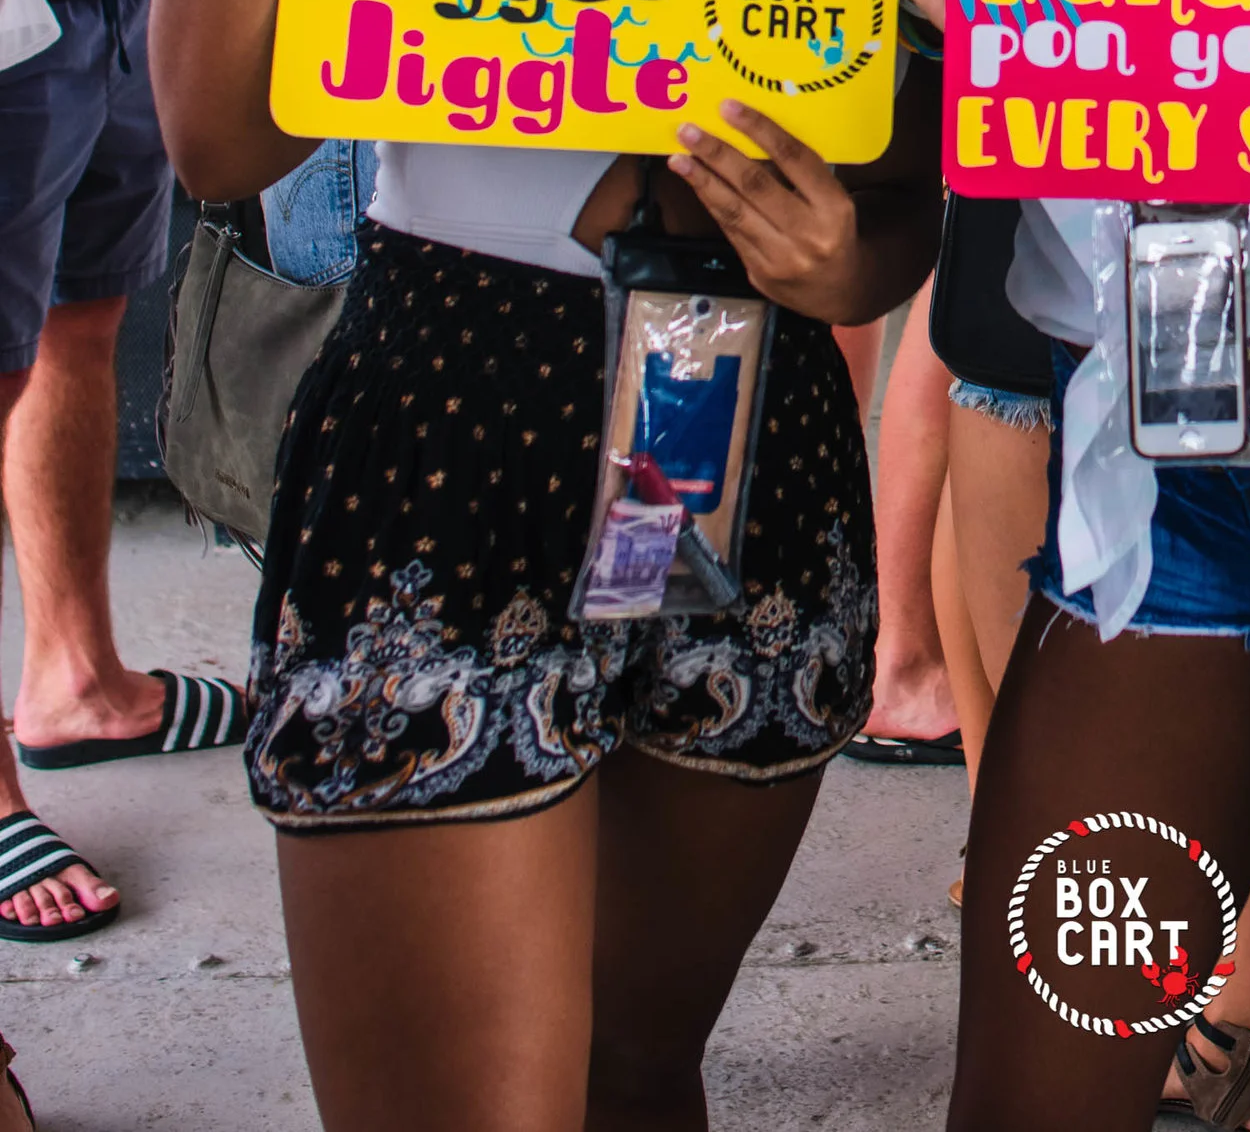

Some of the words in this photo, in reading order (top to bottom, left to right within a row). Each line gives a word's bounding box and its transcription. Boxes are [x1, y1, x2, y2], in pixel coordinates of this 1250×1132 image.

[741, 3, 846, 40] CART
[970, 19, 1136, 88] pon
[321, 0, 689, 134] Jiggle
[956, 95, 1208, 185] EVERY
